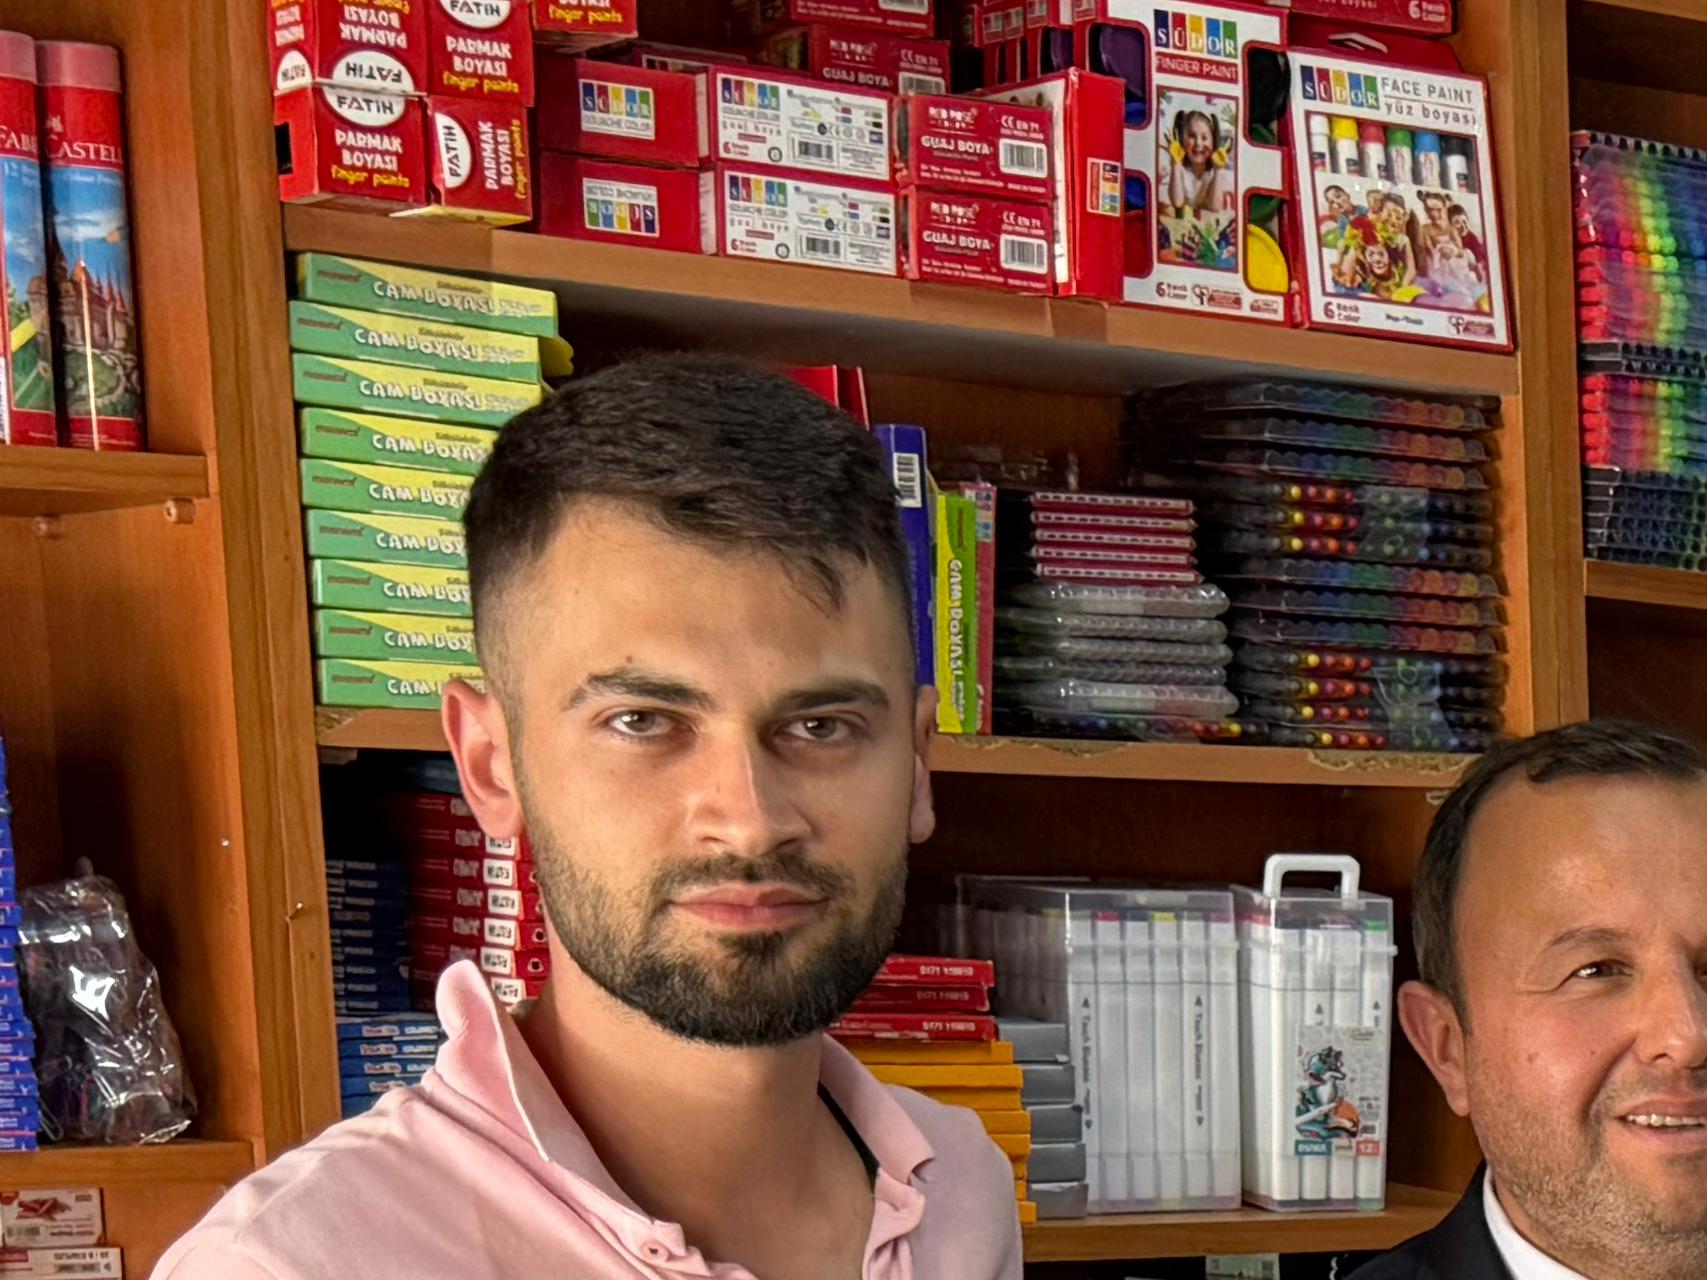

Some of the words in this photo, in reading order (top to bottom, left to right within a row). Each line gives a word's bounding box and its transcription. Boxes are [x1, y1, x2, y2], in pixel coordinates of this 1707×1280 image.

[1408, 0, 1420, 17] 6
[340, 23, 407, 49] PARMAK
[446, 35, 512, 59] PARMAK
[346, 61, 402, 83] FATIH
[453, 56, 507, 77] BOYASI
[822, 66, 856, 80] GUAJ
[858, 72, 889, 87] BOYA
[1156, 54, 1200, 75] FINGER
[1202, 61, 1238, 81] PAINT
[442, 72, 479, 90] finger
[1381, 77, 1422, 98] FACE
[1427, 83, 1475, 105] PAINT
[1303, 78, 1381, 111] SÜDOR
[336, 94, 394, 116] FATIH
[1385, 100, 1415, 118] yüz
[1420, 104, 1477, 127] boyası
[335, 129, 403, 154] PARMAK
[441, 124, 462, 178] FATIH
[920, 135, 955, 152] GUAJ
[957, 141, 990, 155] BOYA
[342, 149, 398, 172] BOYASI
[478, 121, 500, 190] PARMAK
[499, 130, 514, 186] BOYASI
[331, 165, 369, 184] finger
[922, 230, 956, 245] GUAJ
[959, 234, 991, 250] BOYA
[373, 281, 417, 299] CAM
[1156, 281, 1166, 297] 6
[1323, 301, 1336, 318] 6
[354, 328, 399, 346] CAM
[359, 380, 403, 397] CAM
[372, 434, 418, 452] CAM
[368, 483, 413, 501] CAM
[376, 532, 420, 550] CAM
[383, 581, 427, 598] CAM
[384, 631, 428, 648] CAM
[387, 679, 431, 696] CAM
